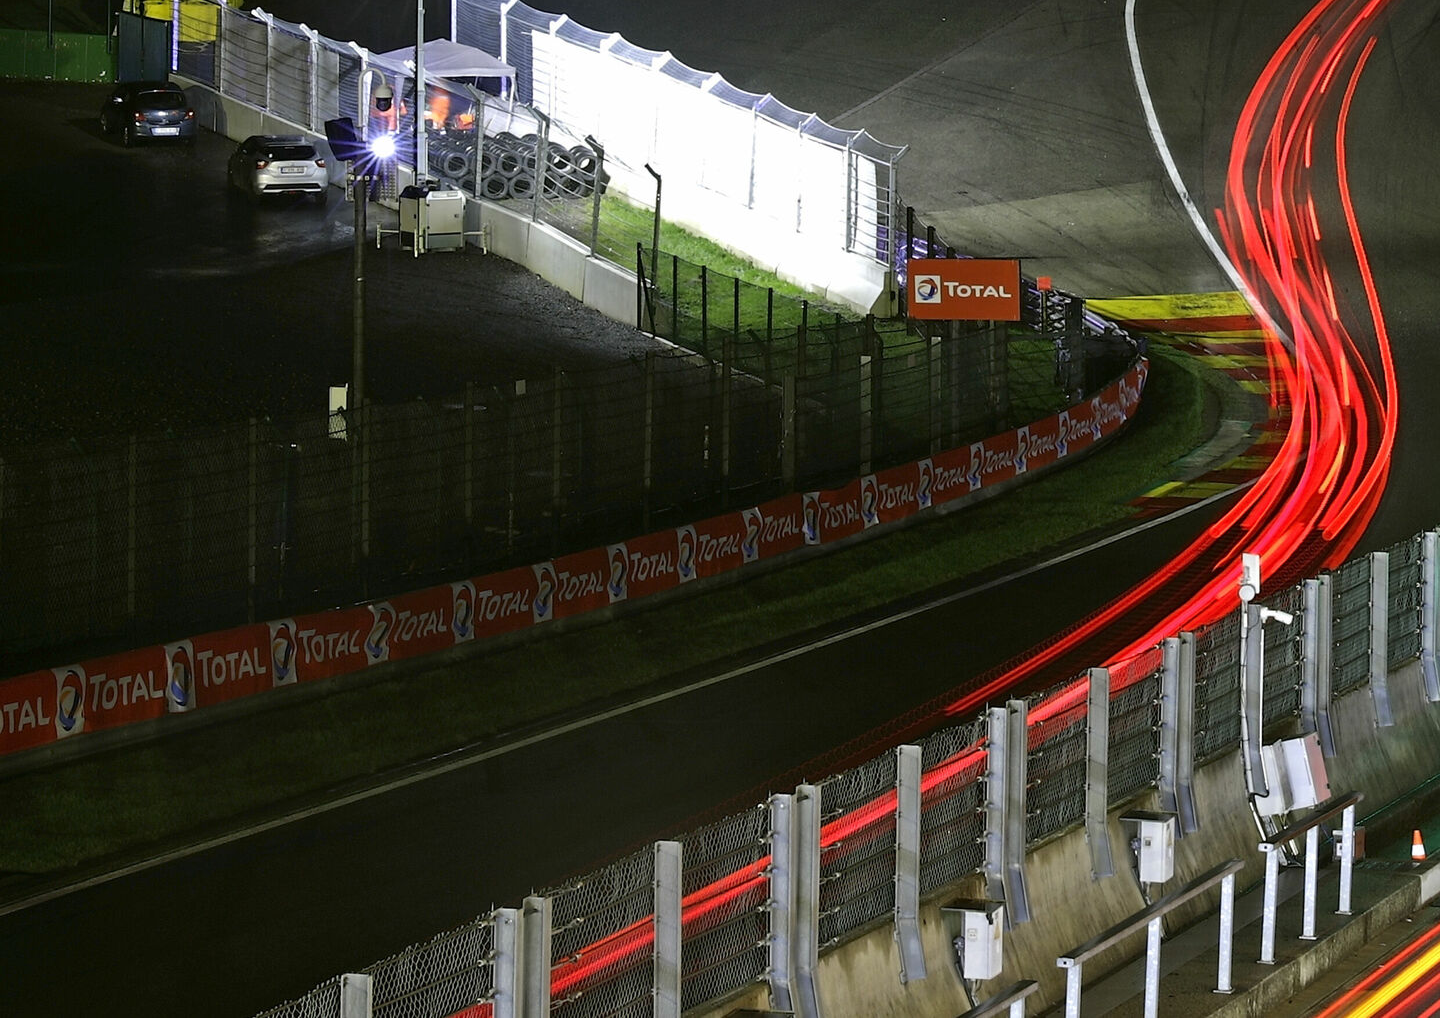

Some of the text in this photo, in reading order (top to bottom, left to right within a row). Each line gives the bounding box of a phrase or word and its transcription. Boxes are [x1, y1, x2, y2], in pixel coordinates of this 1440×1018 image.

[944, 282, 1012, 298] TOTAL
[89, 670, 165, 711] TOTAL
[197, 648, 266, 687] TOTAL
[298, 628, 360, 664] TOTAL
[394, 608, 447, 642] TOTAL
[477, 589, 529, 621] TOTAL
[557, 570, 603, 600] TOTAL
[629, 549, 674, 581] TOTAL
[697, 532, 739, 562] TOTAL
[761, 513, 799, 542] TOTAL
[820, 499, 860, 529] TOTAL
[879, 481, 915, 510] TOTAL
[933, 465, 966, 492] TOTAL
[982, 449, 1014, 474] TOTAL
[1028, 433, 1056, 457] TOTAL
